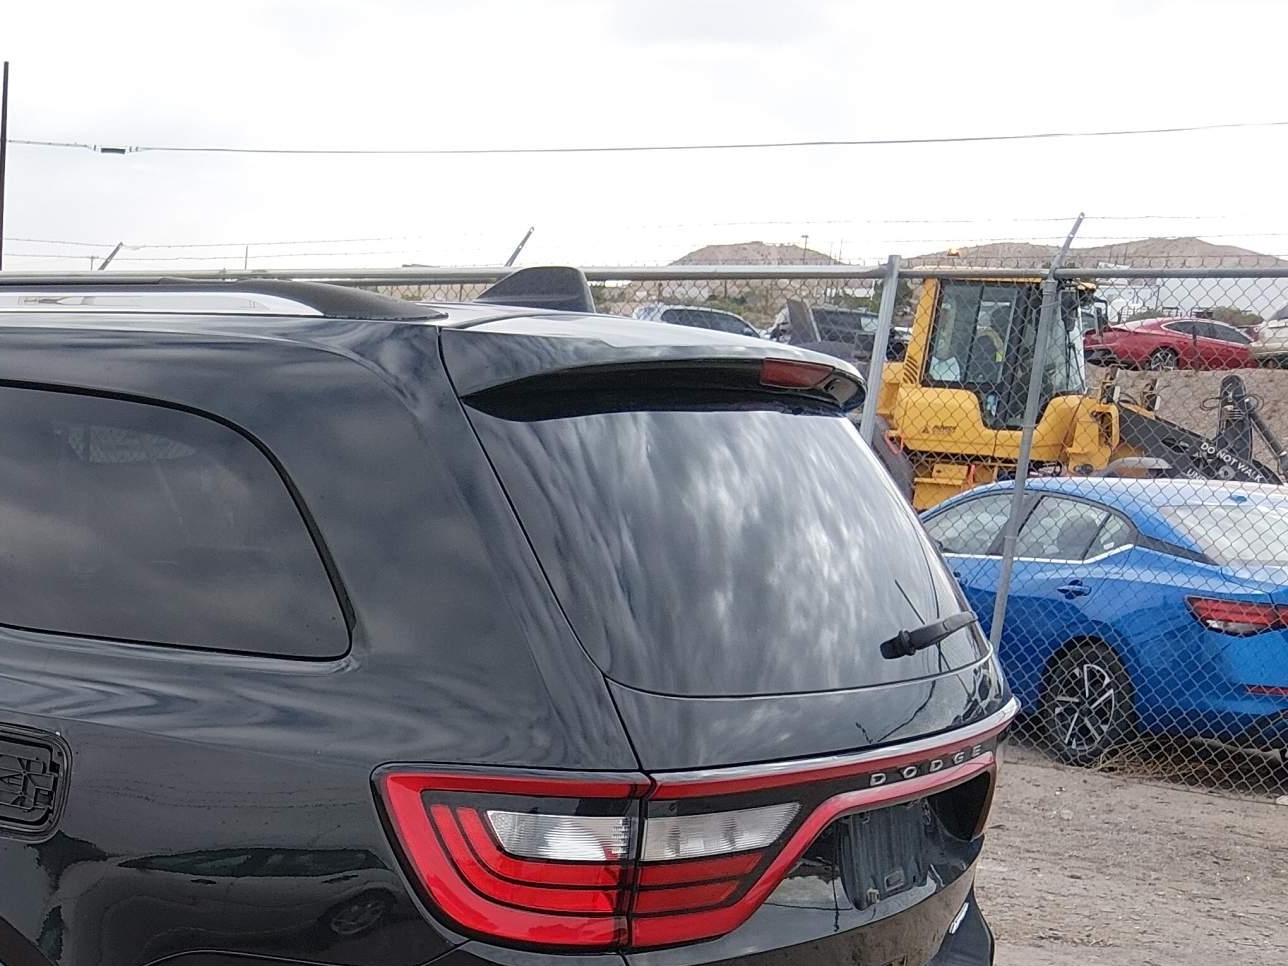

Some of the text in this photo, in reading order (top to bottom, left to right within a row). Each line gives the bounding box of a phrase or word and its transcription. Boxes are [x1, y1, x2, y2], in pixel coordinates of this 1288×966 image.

[1200, 441, 1264, 482] DO NOT WALK
[869, 744, 982, 787] DODGE
